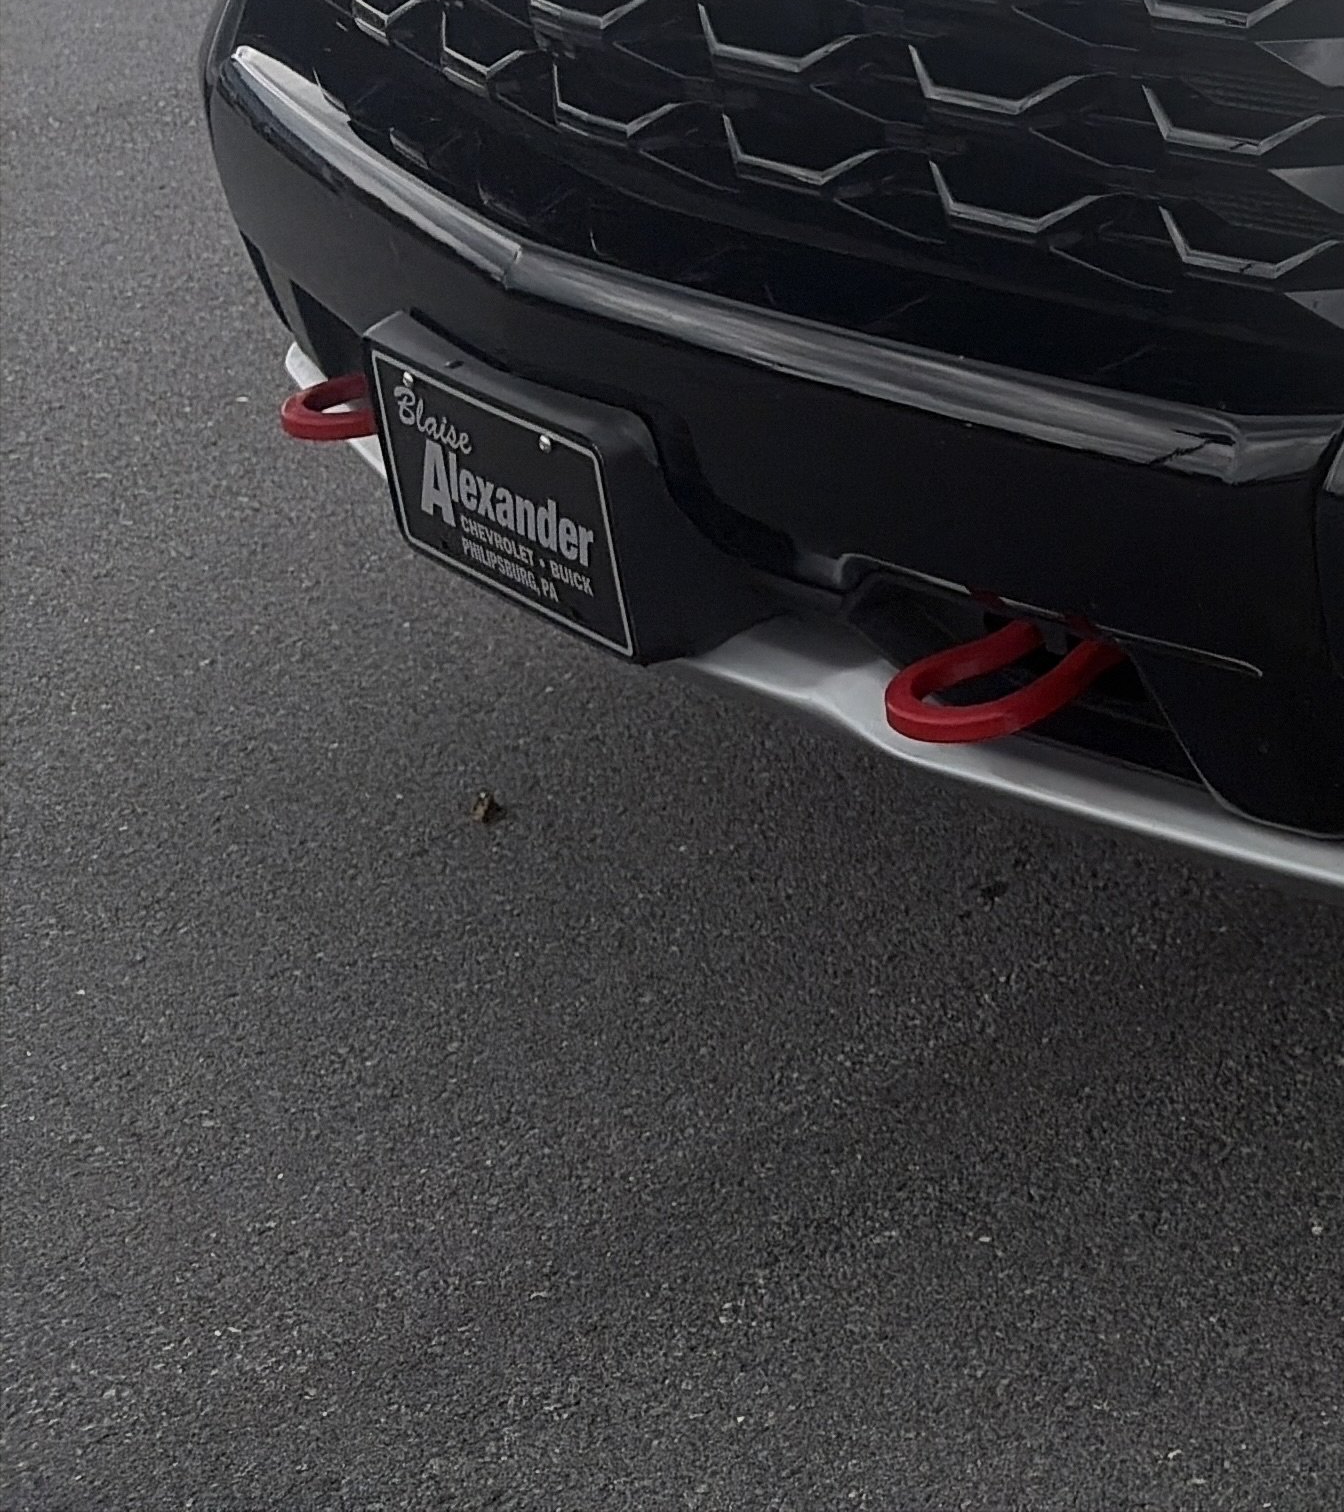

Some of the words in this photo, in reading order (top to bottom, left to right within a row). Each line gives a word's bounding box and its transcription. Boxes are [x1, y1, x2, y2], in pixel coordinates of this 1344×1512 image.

[394, 386, 472, 455] Blaise
[420, 439, 594, 567] Alexander
[460, 514, 535, 568] CHEVROLET
[549, 560, 594, 597] BUICK
[540, 577, 559, 603] PA
